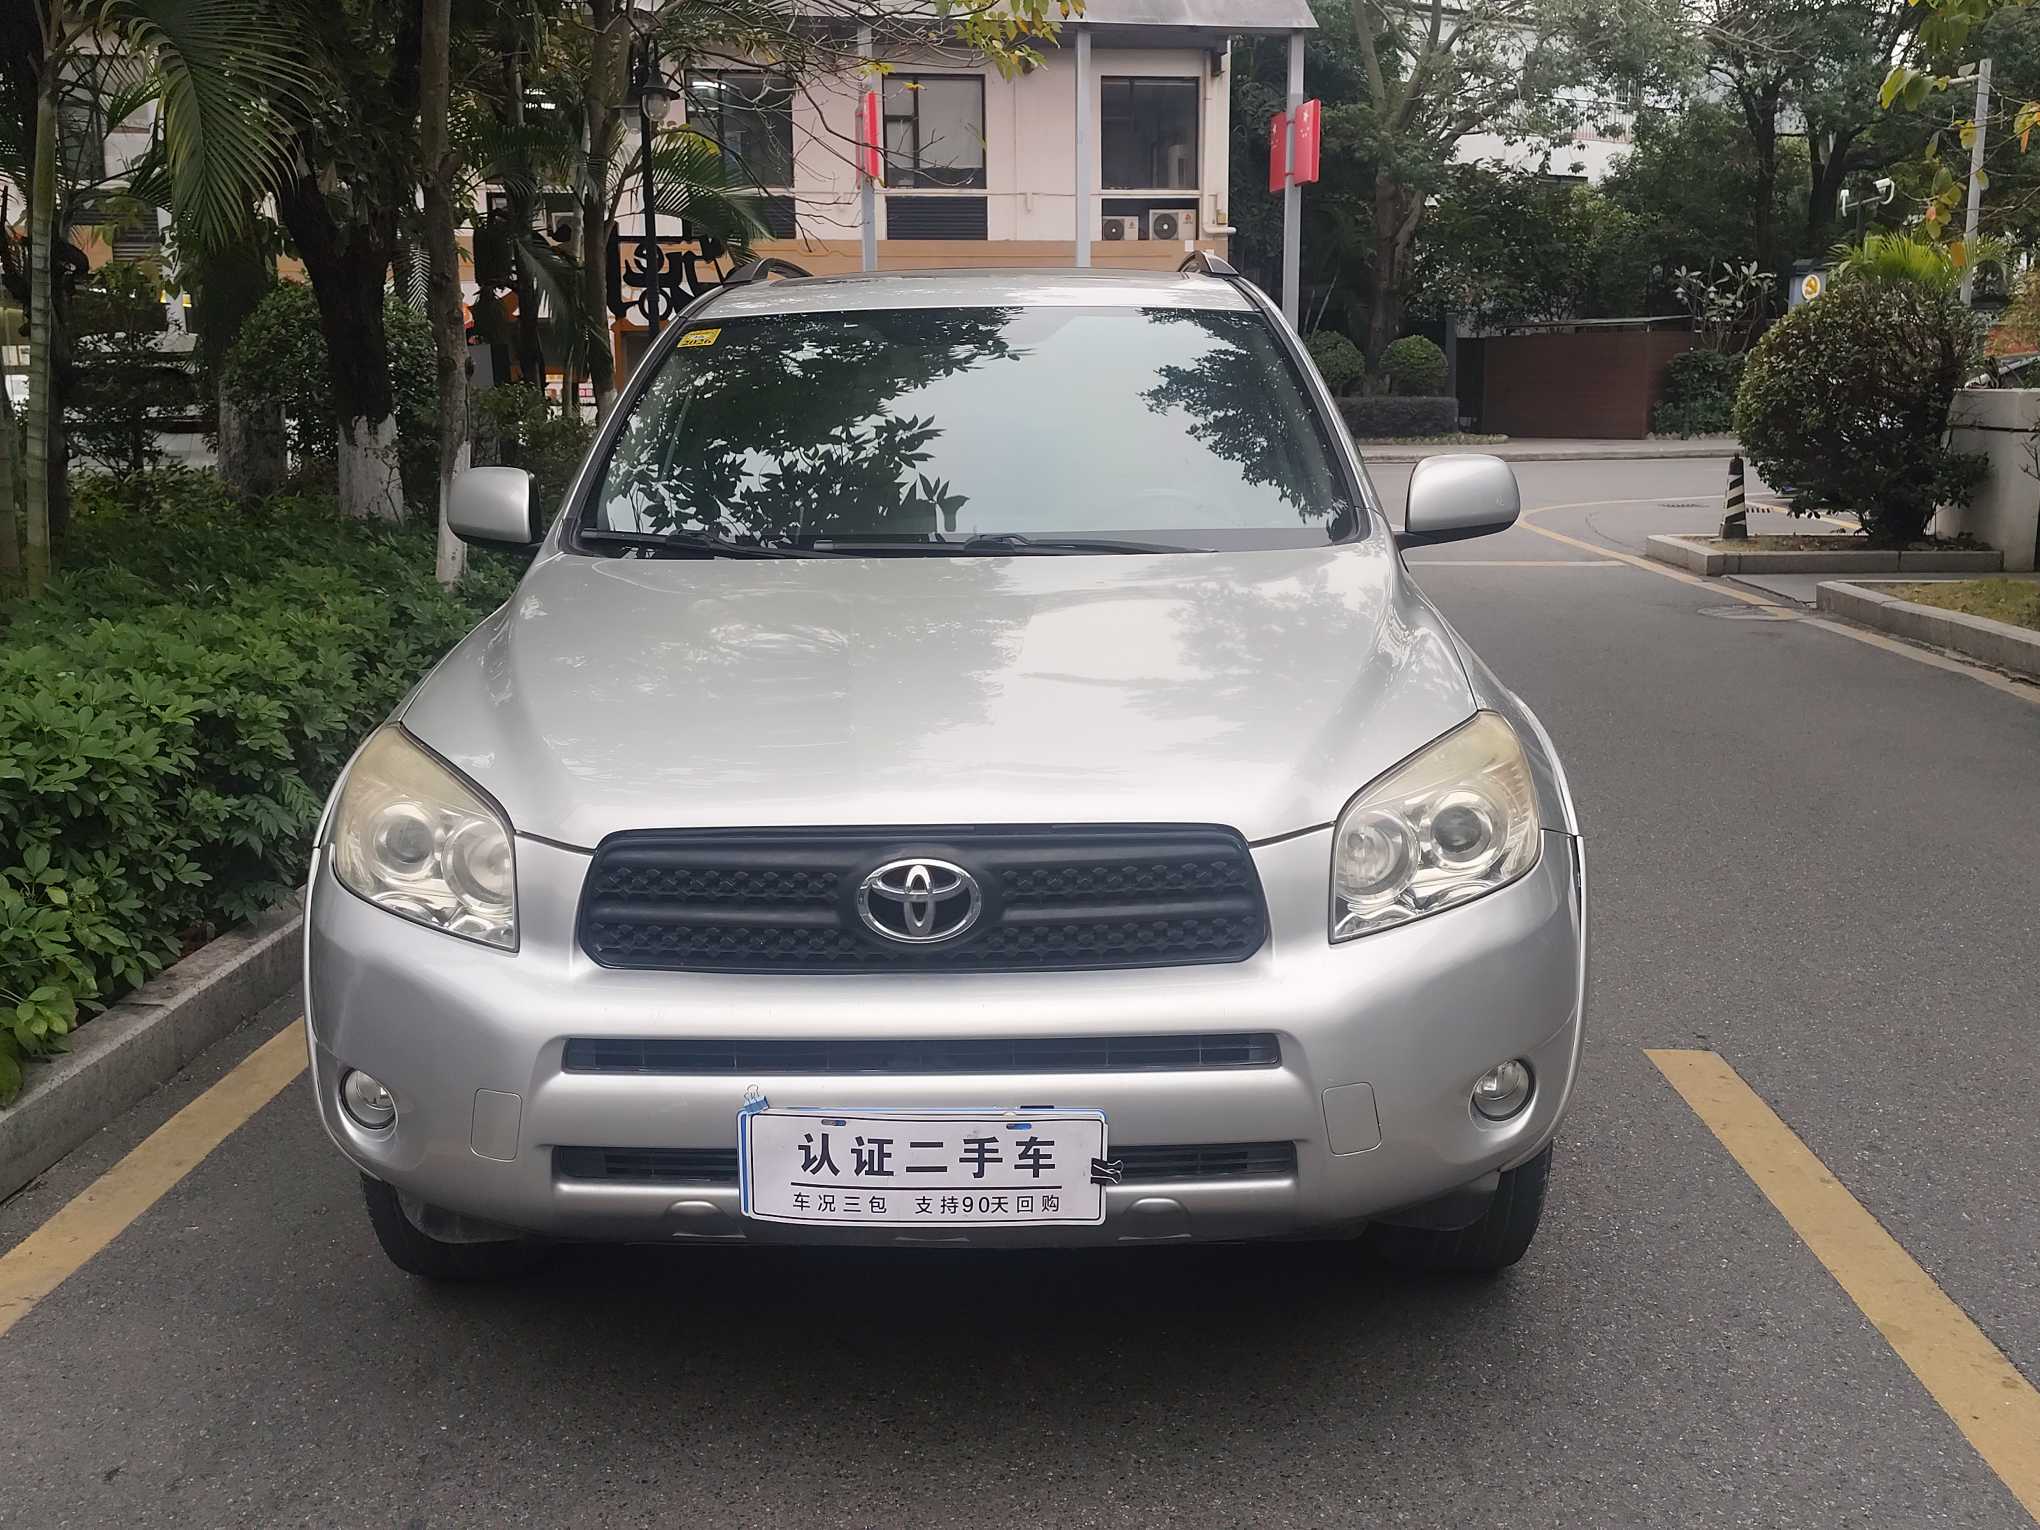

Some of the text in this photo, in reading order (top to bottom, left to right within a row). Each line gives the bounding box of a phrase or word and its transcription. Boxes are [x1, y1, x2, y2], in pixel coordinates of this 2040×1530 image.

[797, 1132, 1056, 1179] 认证二手车
[792, 1192, 1060, 1215] 车况三包 支持90天回购
